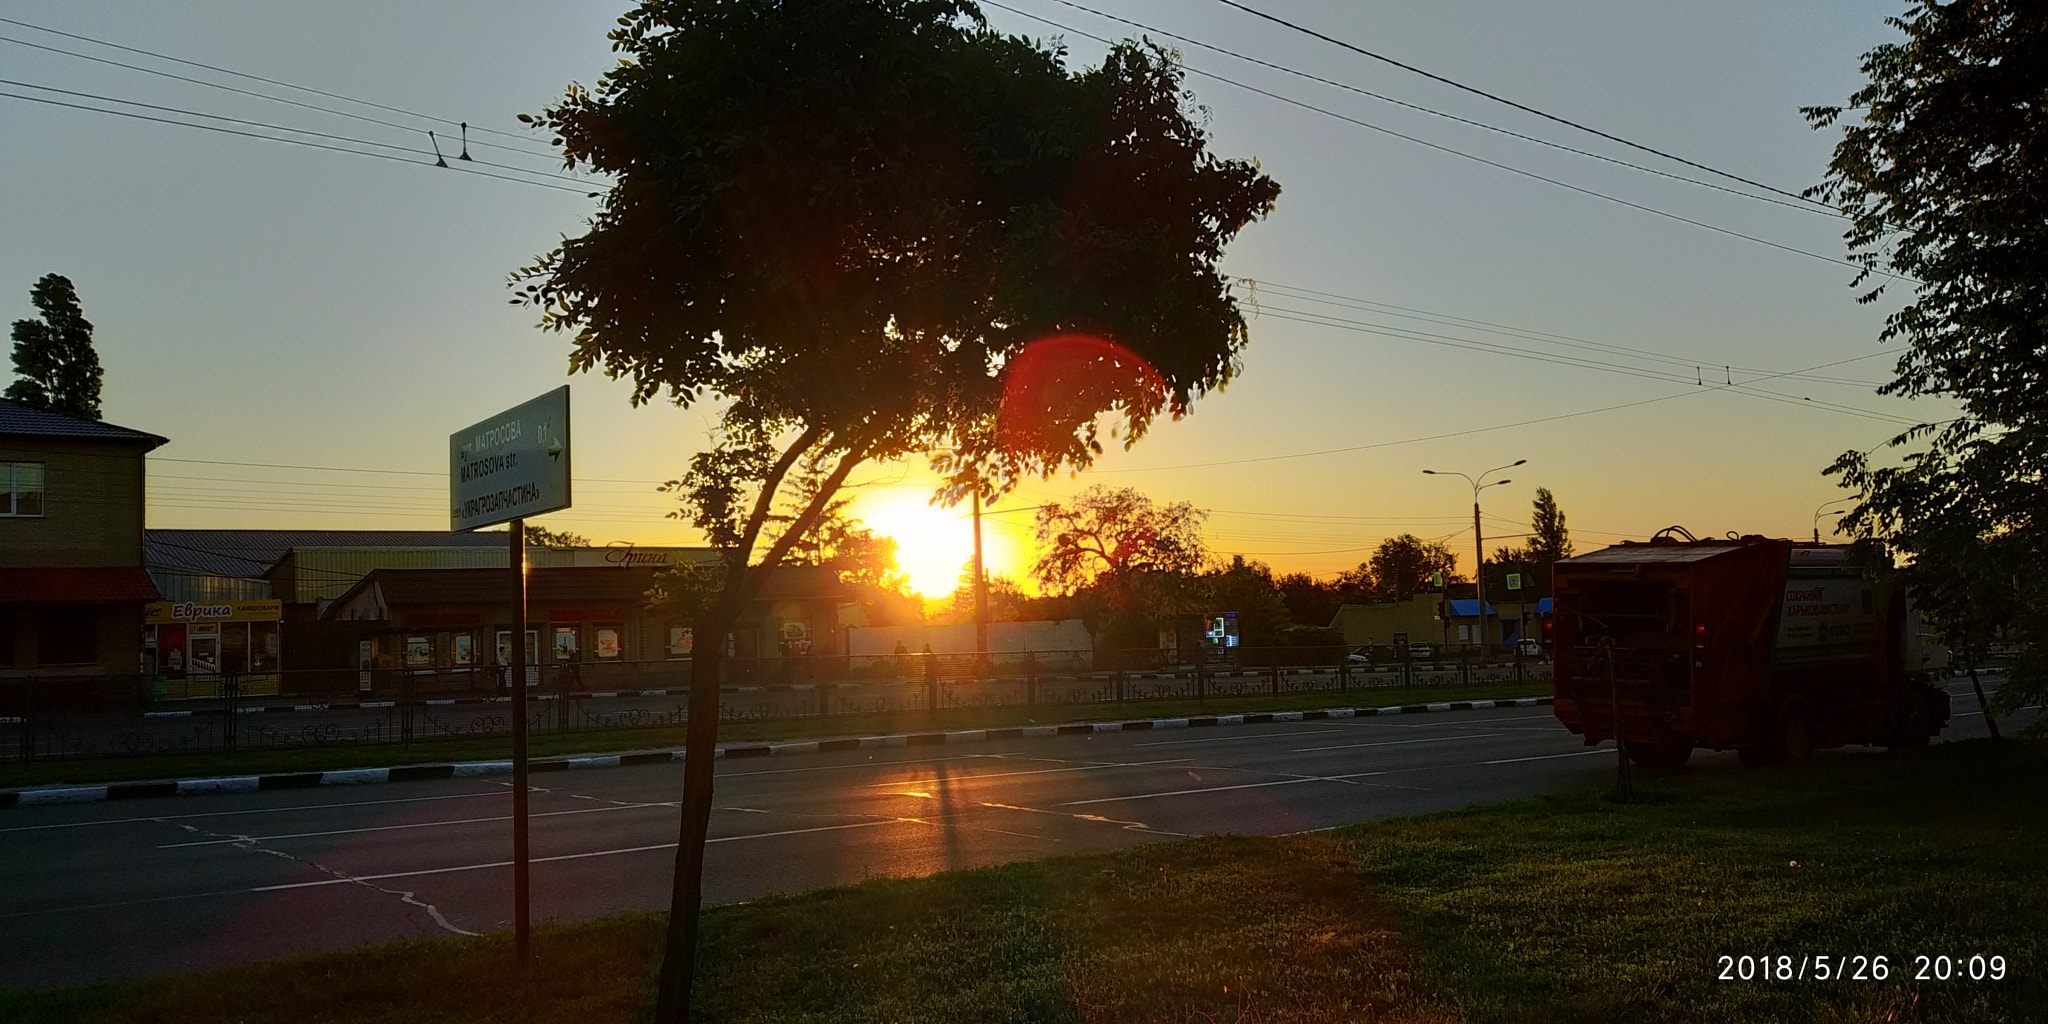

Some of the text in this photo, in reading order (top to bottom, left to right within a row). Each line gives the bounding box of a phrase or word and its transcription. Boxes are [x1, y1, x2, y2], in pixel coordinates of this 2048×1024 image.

[475, 419, 522, 454] МАТРОСОВА
[460, 452, 518, 484] MATROSOVA str.
[172, 602, 232, 621] Еврика
